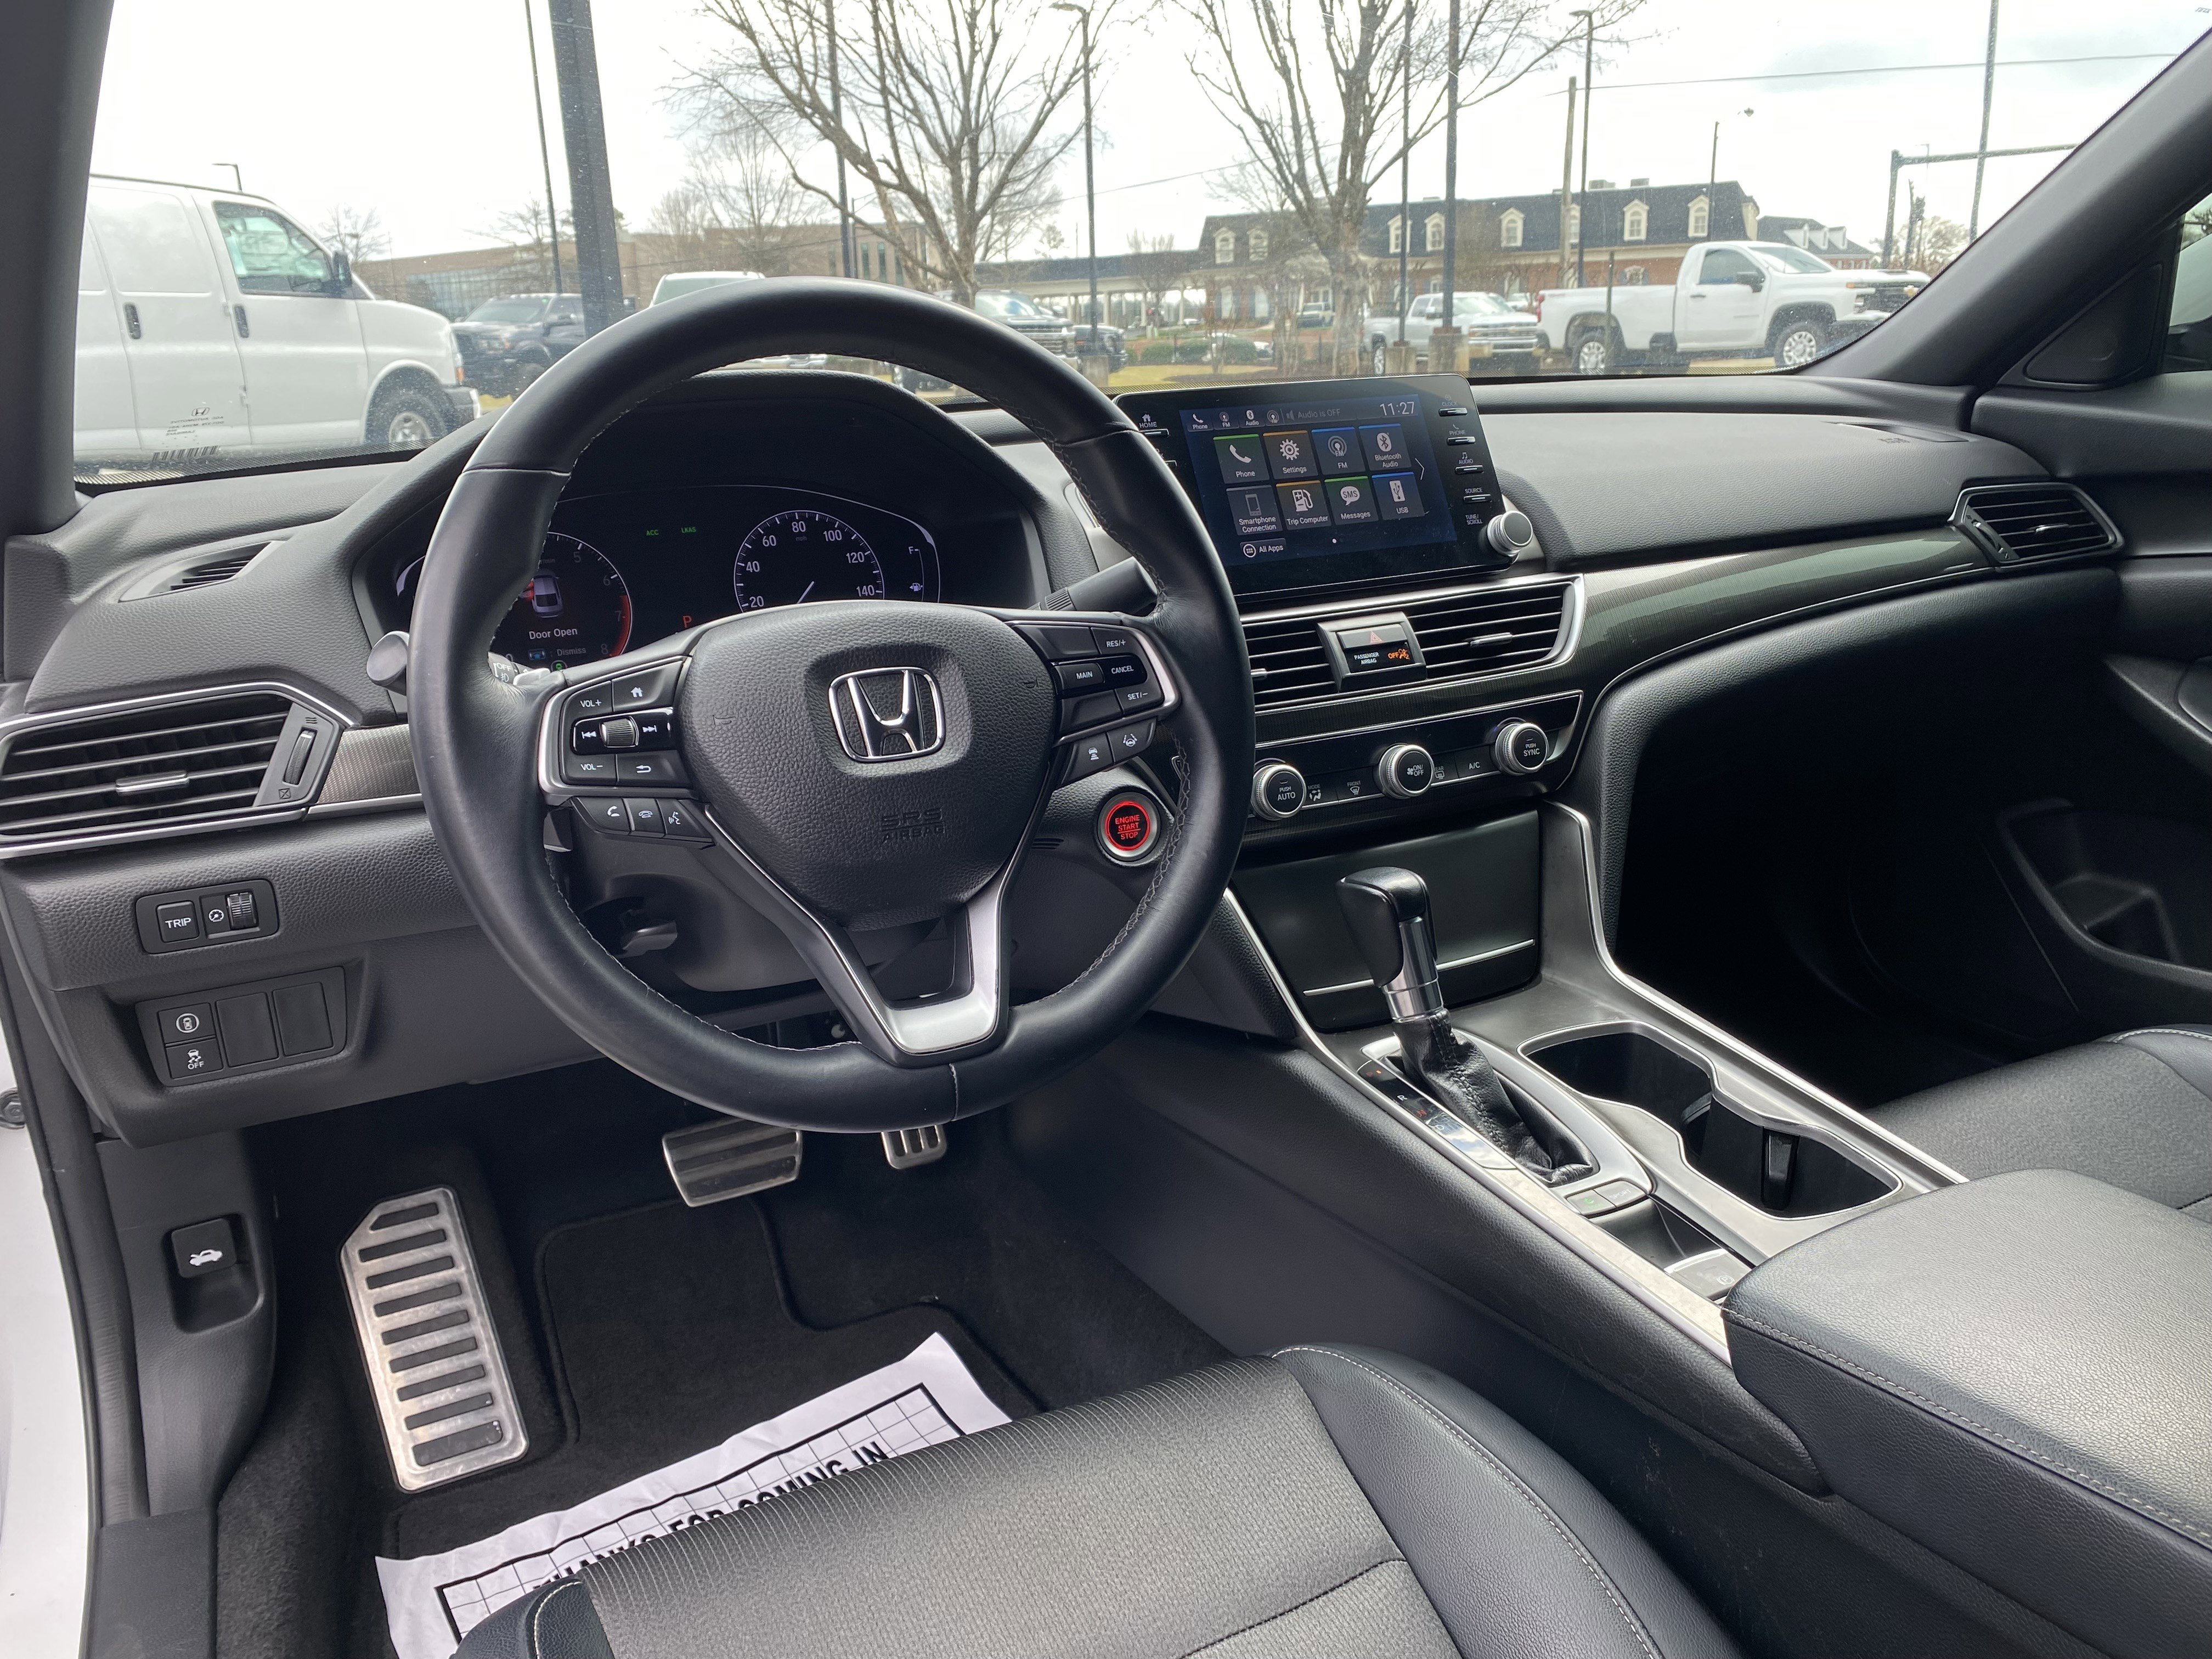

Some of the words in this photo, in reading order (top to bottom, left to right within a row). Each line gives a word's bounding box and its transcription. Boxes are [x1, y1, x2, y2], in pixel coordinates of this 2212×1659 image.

[1297, 410, 1317, 418] Audio
[1327, 408, 1341, 417] OFF
[1379, 402, 1415, 416] 11:27
[1239, 516, 1276, 525] Smartphone
[1301, 515, 1329, 524] Computer
[1341, 511, 1371, 520] Messages
[792, 521, 806, 533] 80
[1242, 524, 1277, 533] Connection
[823, 529, 843, 541] 100
[763, 535, 777, 547] 60
[1268, 544, 1284, 554] Apps
[573, 552, 582, 563] 5
[846, 551, 865, 563] 120
[746, 561, 760, 573] 40
[603, 577, 610, 586] 6
[856, 584, 875, 597] 140
[749, 596, 764, 608] 20
[614, 611, 622, 622] 7
[682, 616, 692, 628] P
[529, 631, 551, 640] Door
[554, 628, 578, 637] Open
[556, 647, 586, 656] Dismiss
[601, 644, 608, 655] 8
[1354, 652, 1380, 660] PASSENGER
[496, 663, 512, 672] OFF
[1111, 665, 1134, 674] CANCEL
[1076, 671, 1093, 680] MAIN
[1523, 748, 1540, 757] SYNC
[1469, 761, 1480, 770] A/C
[1277, 792, 1296, 801] AUTO
[1115, 815, 1140, 824] ENGINE
[1119, 822, 1139, 832] START
[1121, 832, 1138, 840] STOP
[165, 917, 191, 928] TRIP
[188, 1061, 204, 1070] OFF
[1609, 1188, 1632, 1199] SPORT
